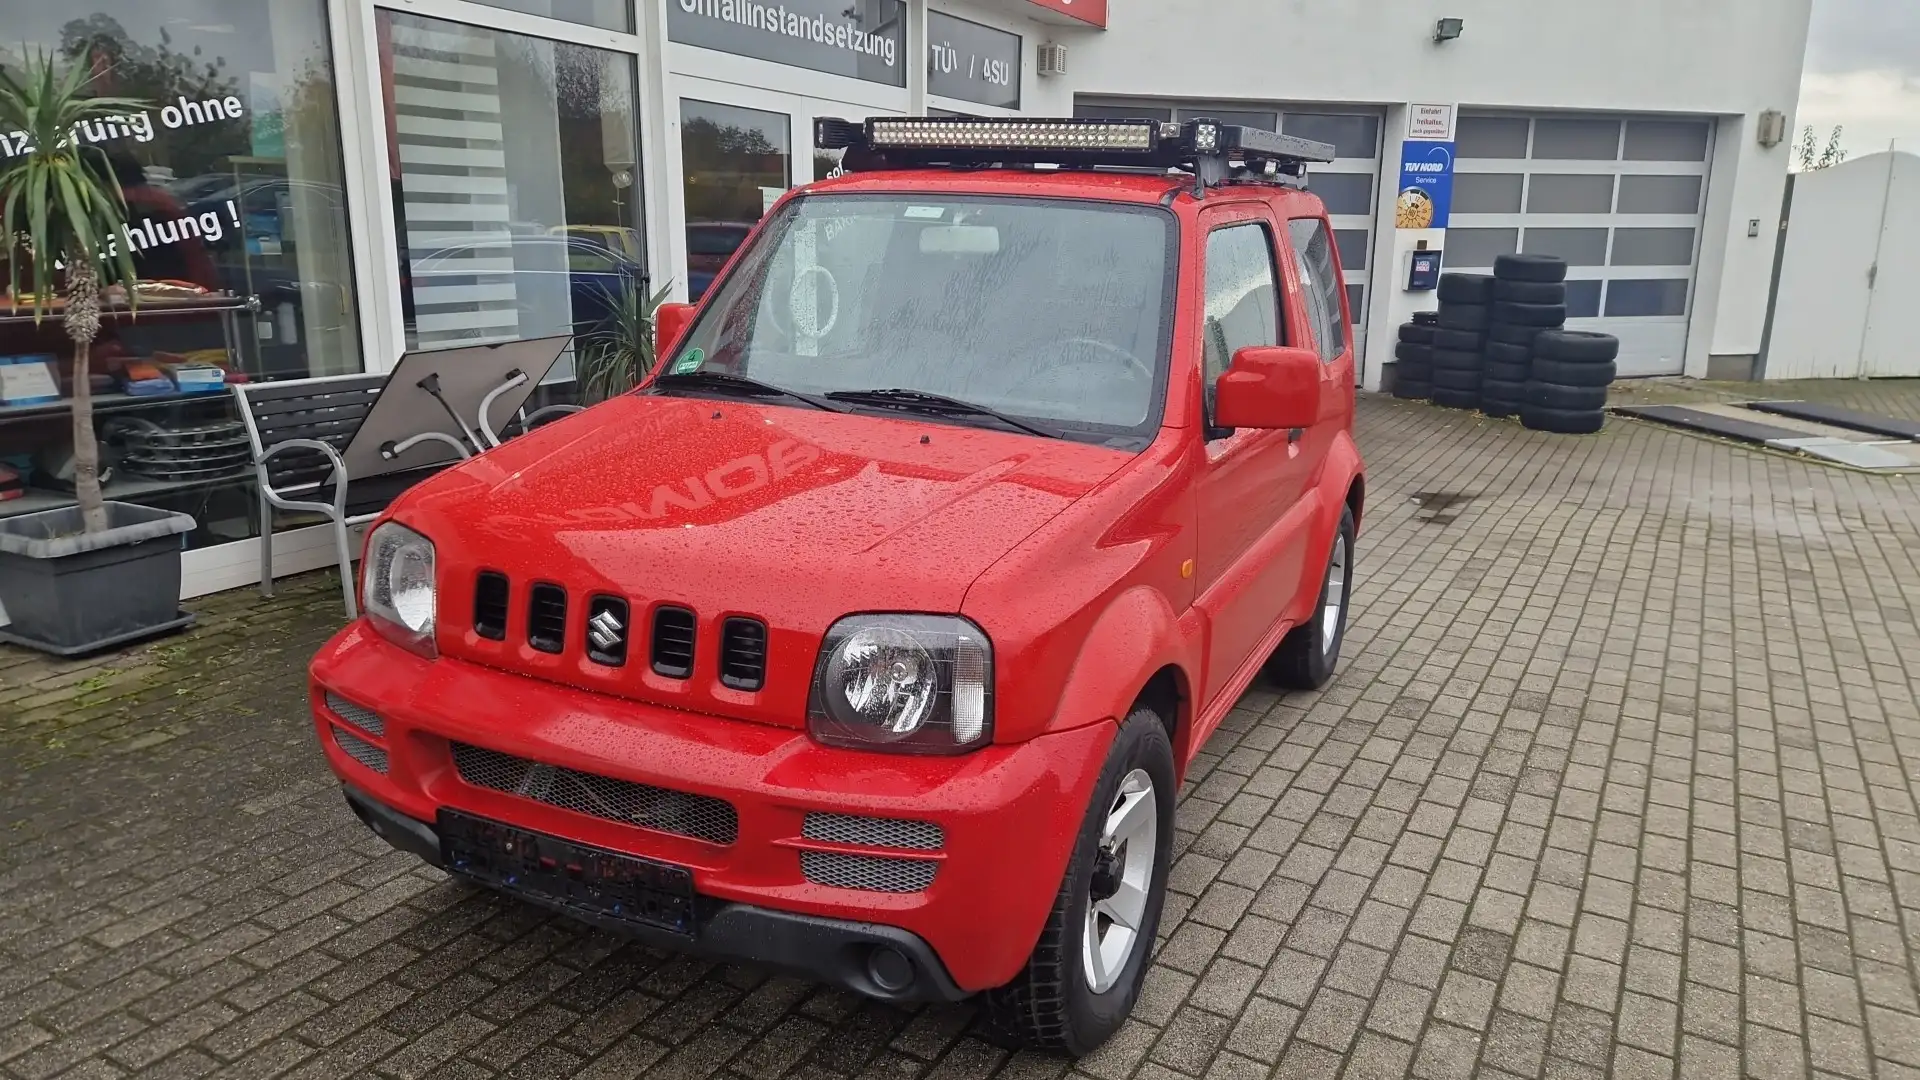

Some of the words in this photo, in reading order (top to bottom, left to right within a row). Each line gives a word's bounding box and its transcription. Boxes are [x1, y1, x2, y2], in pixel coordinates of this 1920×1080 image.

[161, 95, 243, 129] ohne
[1420, 162, 1443, 172] NORD
[1415, 176, 1437, 184] Service
[226, 200, 241, 228] !
